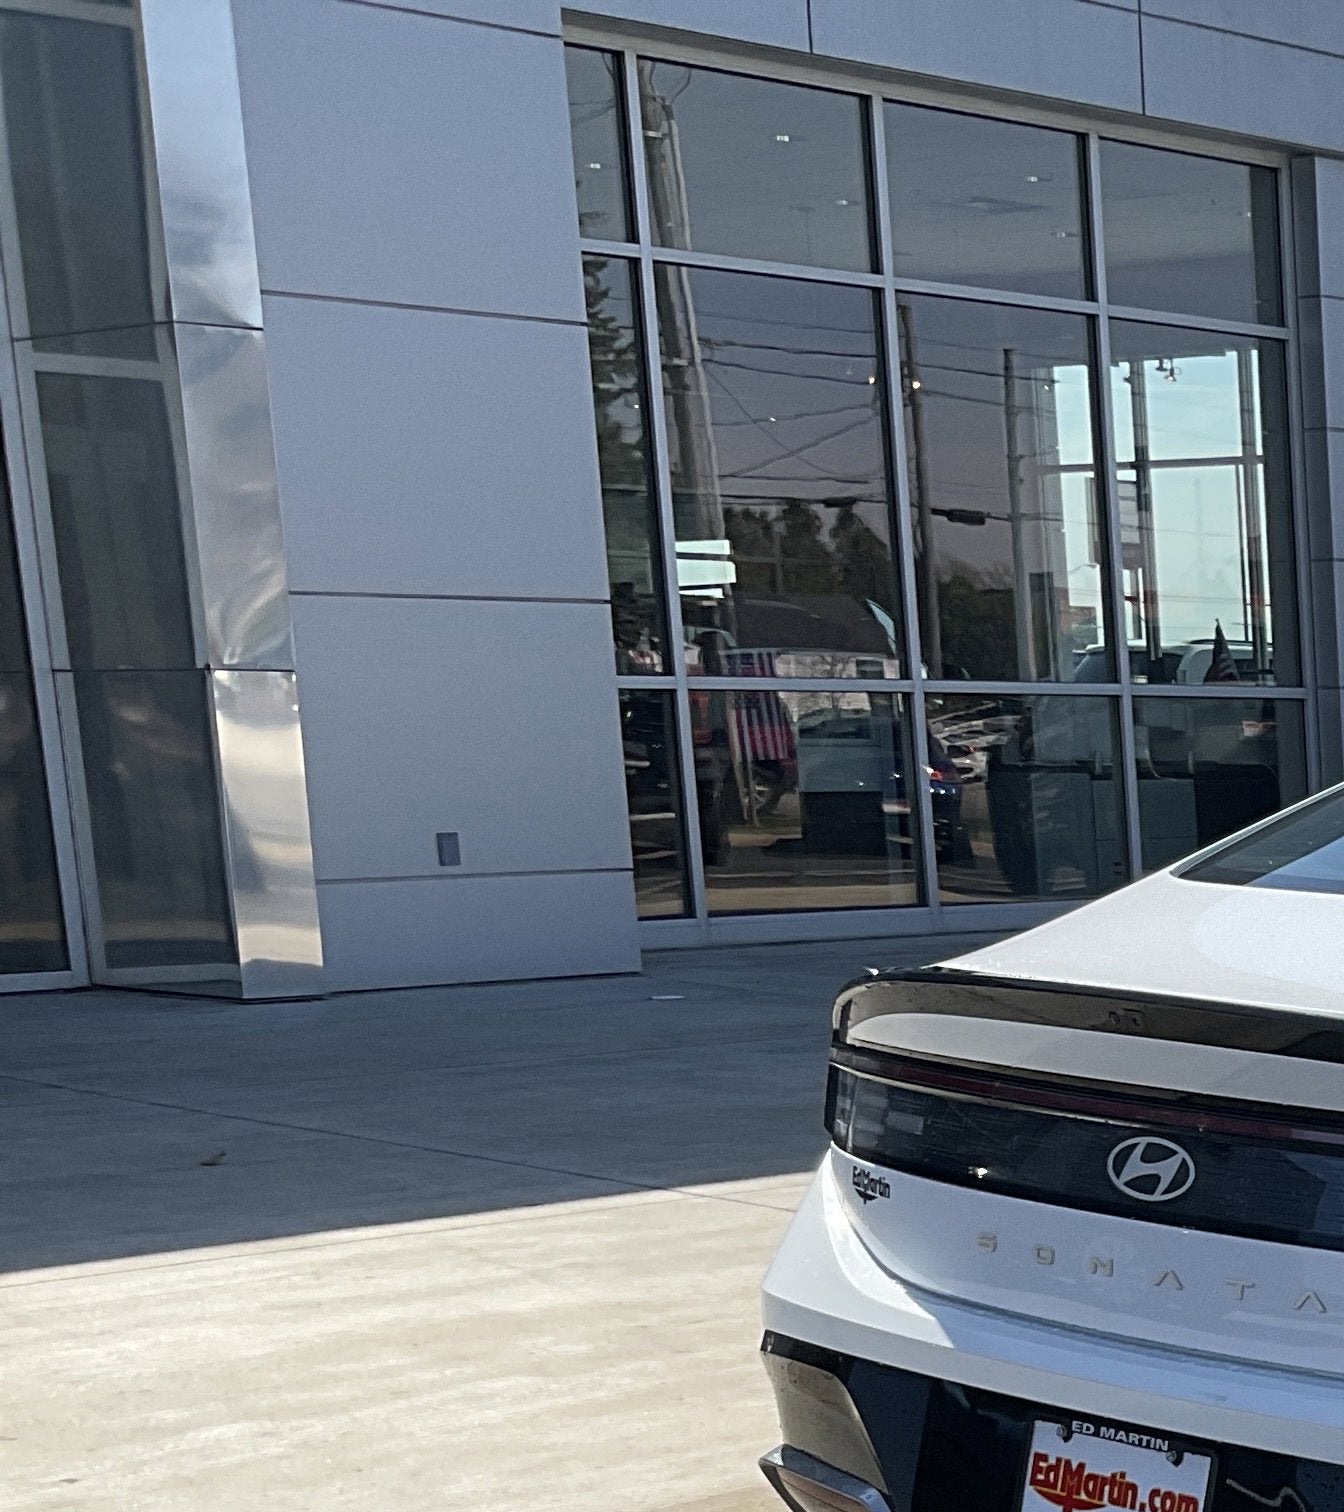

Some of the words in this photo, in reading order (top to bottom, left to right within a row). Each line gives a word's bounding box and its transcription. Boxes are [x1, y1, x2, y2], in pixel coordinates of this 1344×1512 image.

[975, 1231, 1328, 1314] SONATA
[1071, 1420, 1095, 1435] ED
[1099, 1426, 1169, 1452] MARTIN
